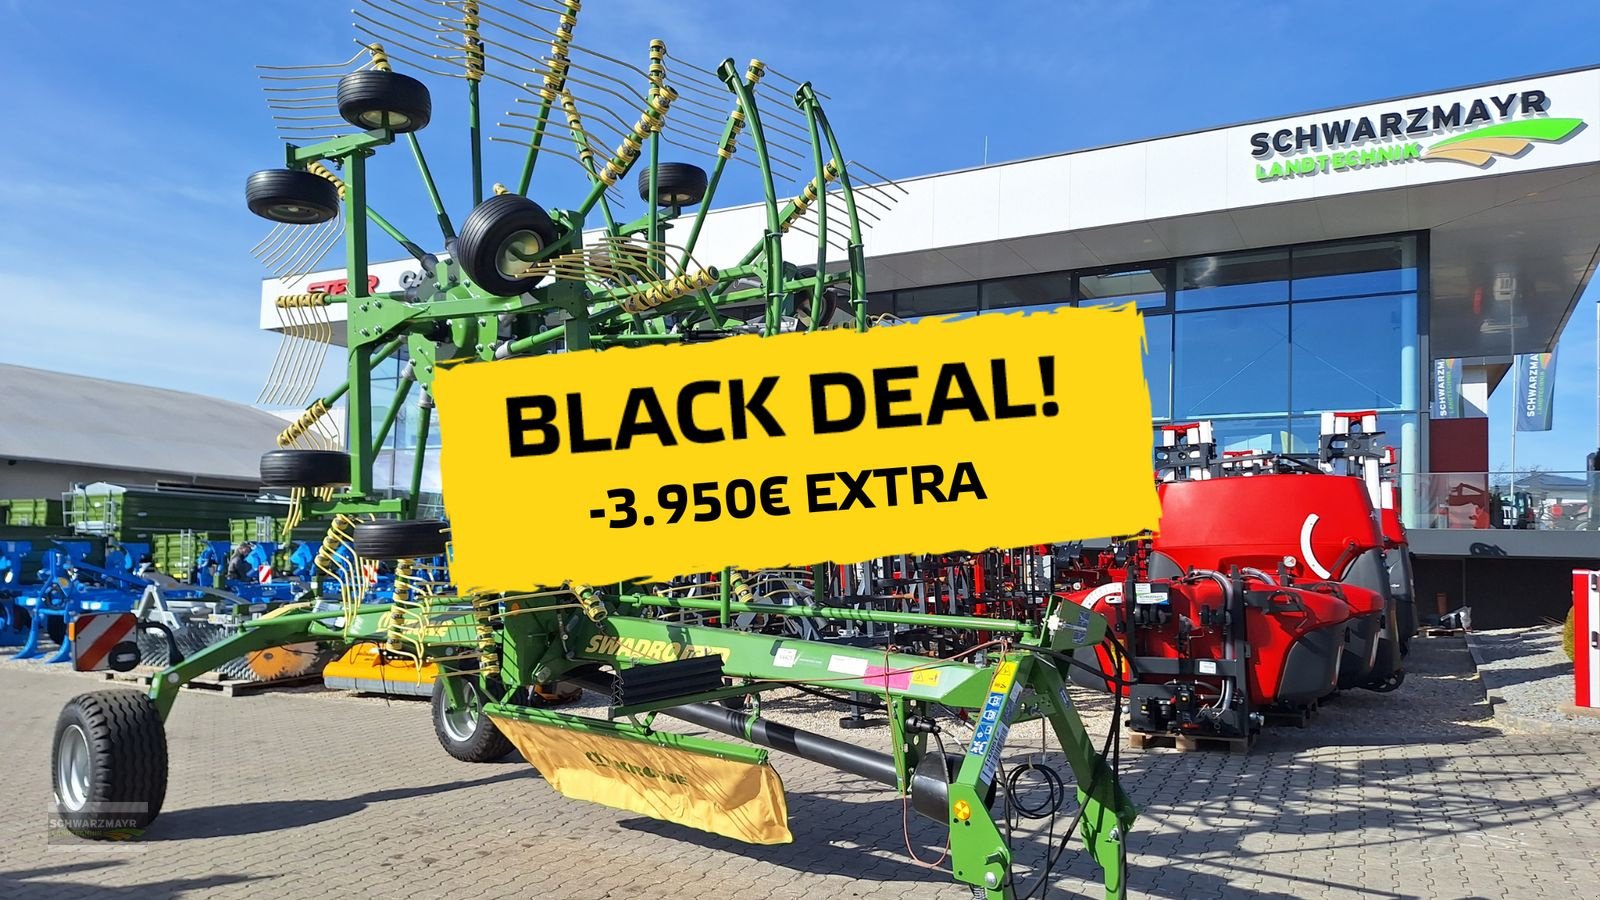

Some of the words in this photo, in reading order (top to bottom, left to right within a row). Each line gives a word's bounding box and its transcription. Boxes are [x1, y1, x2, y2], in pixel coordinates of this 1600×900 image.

[1250, 90, 1547, 156] SCHWARZMAYR
[1255, 141, 1421, 180] LANDTECHNIK
[1526, 352, 1539, 417] SCHWARZMA
[585, 634, 681, 662] SWADRO
